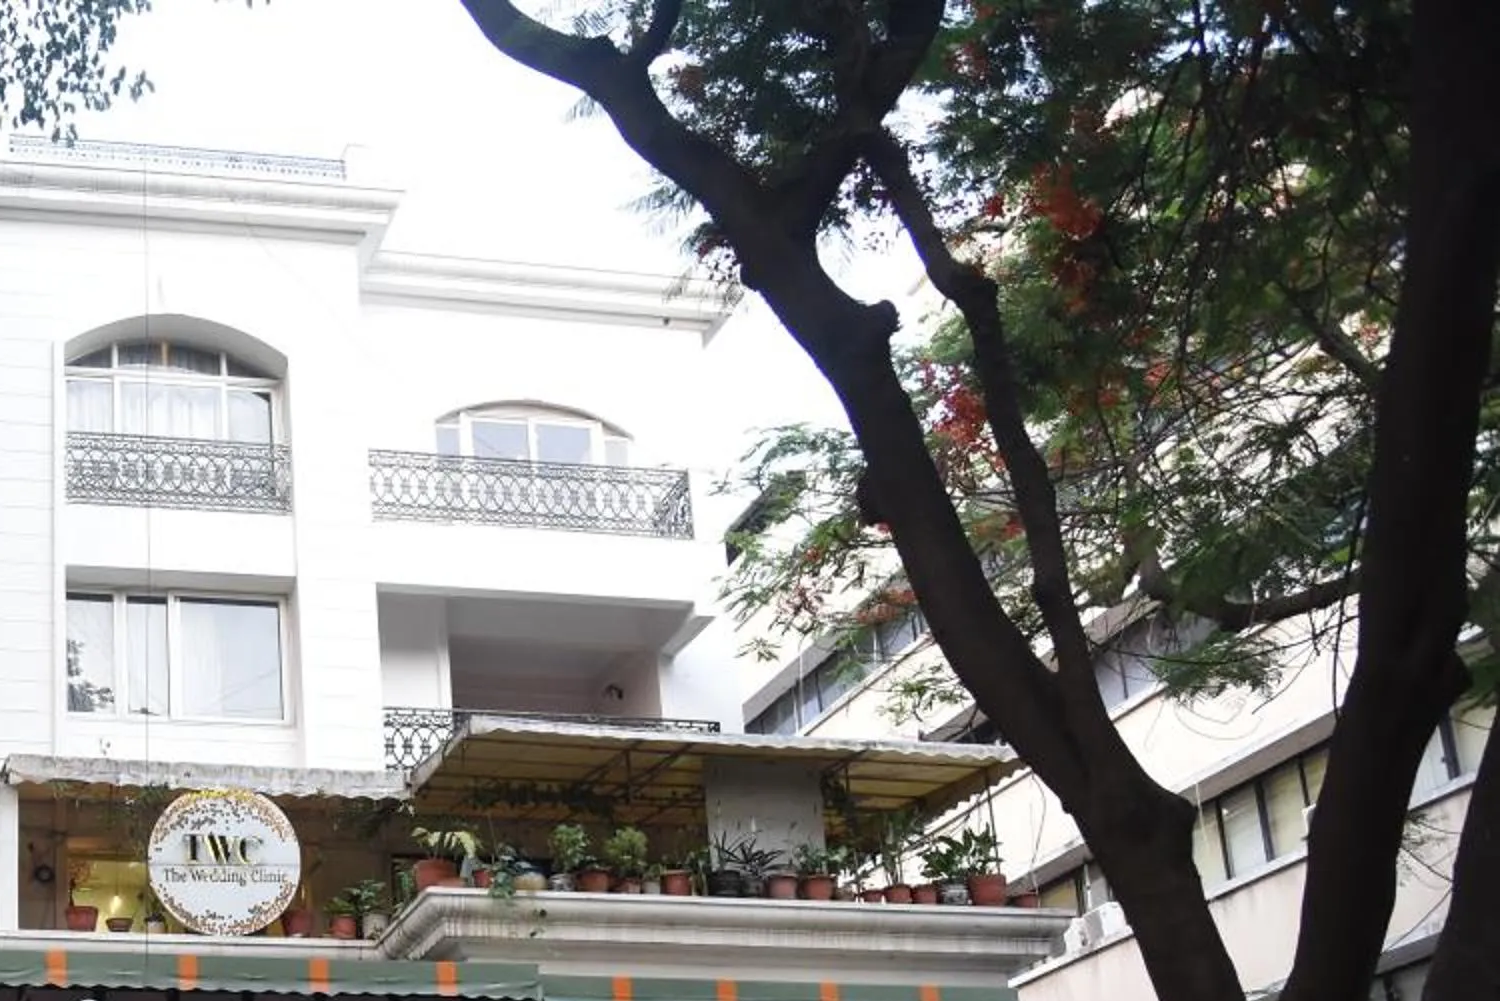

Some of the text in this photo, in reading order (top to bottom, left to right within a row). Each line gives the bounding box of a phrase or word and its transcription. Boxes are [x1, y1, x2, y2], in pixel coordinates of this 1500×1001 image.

[183, 833, 264, 864] TWC
[164, 869, 287, 886] The Wedding Clinic
